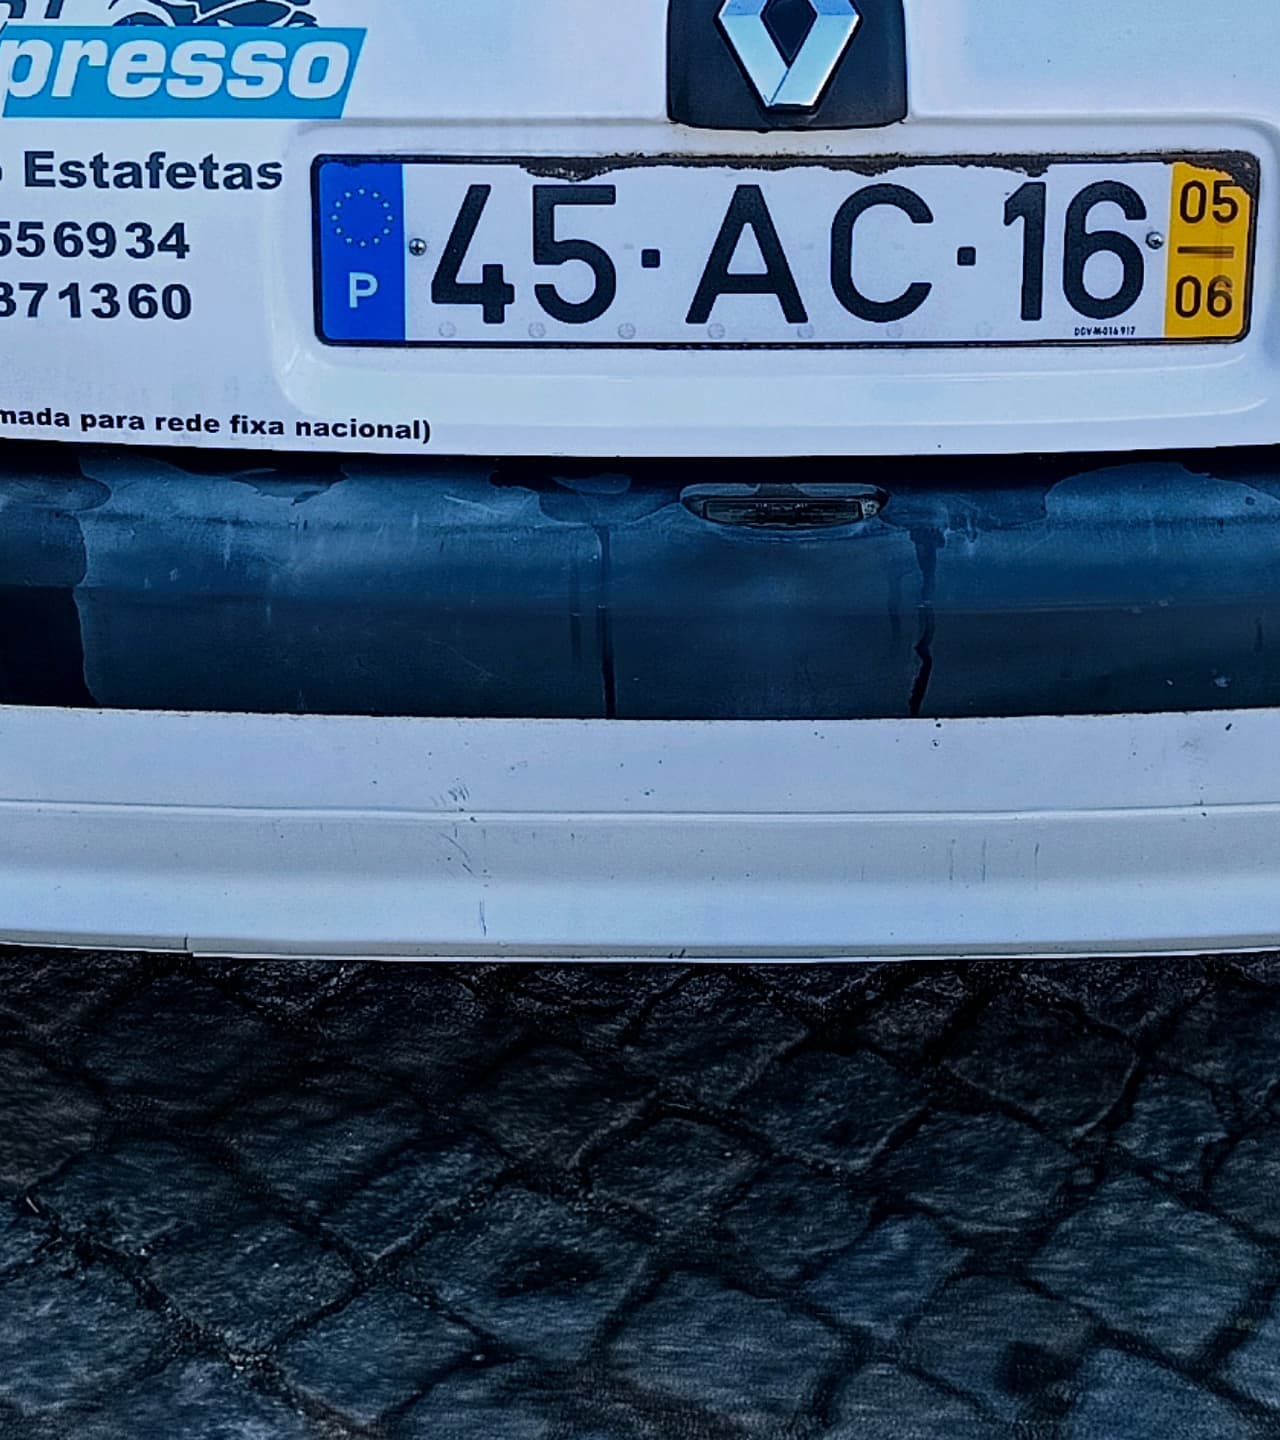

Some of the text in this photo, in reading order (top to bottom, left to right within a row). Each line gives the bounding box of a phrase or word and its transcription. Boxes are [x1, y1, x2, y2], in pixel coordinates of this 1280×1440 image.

[24, 150, 283, 191] Estafetas
[1180, 180, 1239, 224] 05
[348, 272, 378, 308] P
[1175, 275, 1233, 318] 06
[80, 412, 145, 432] para
[155, 414, 220, 434] rede
[229, 415, 285, 436] fixa
[295, 419, 431, 444] nacional)
